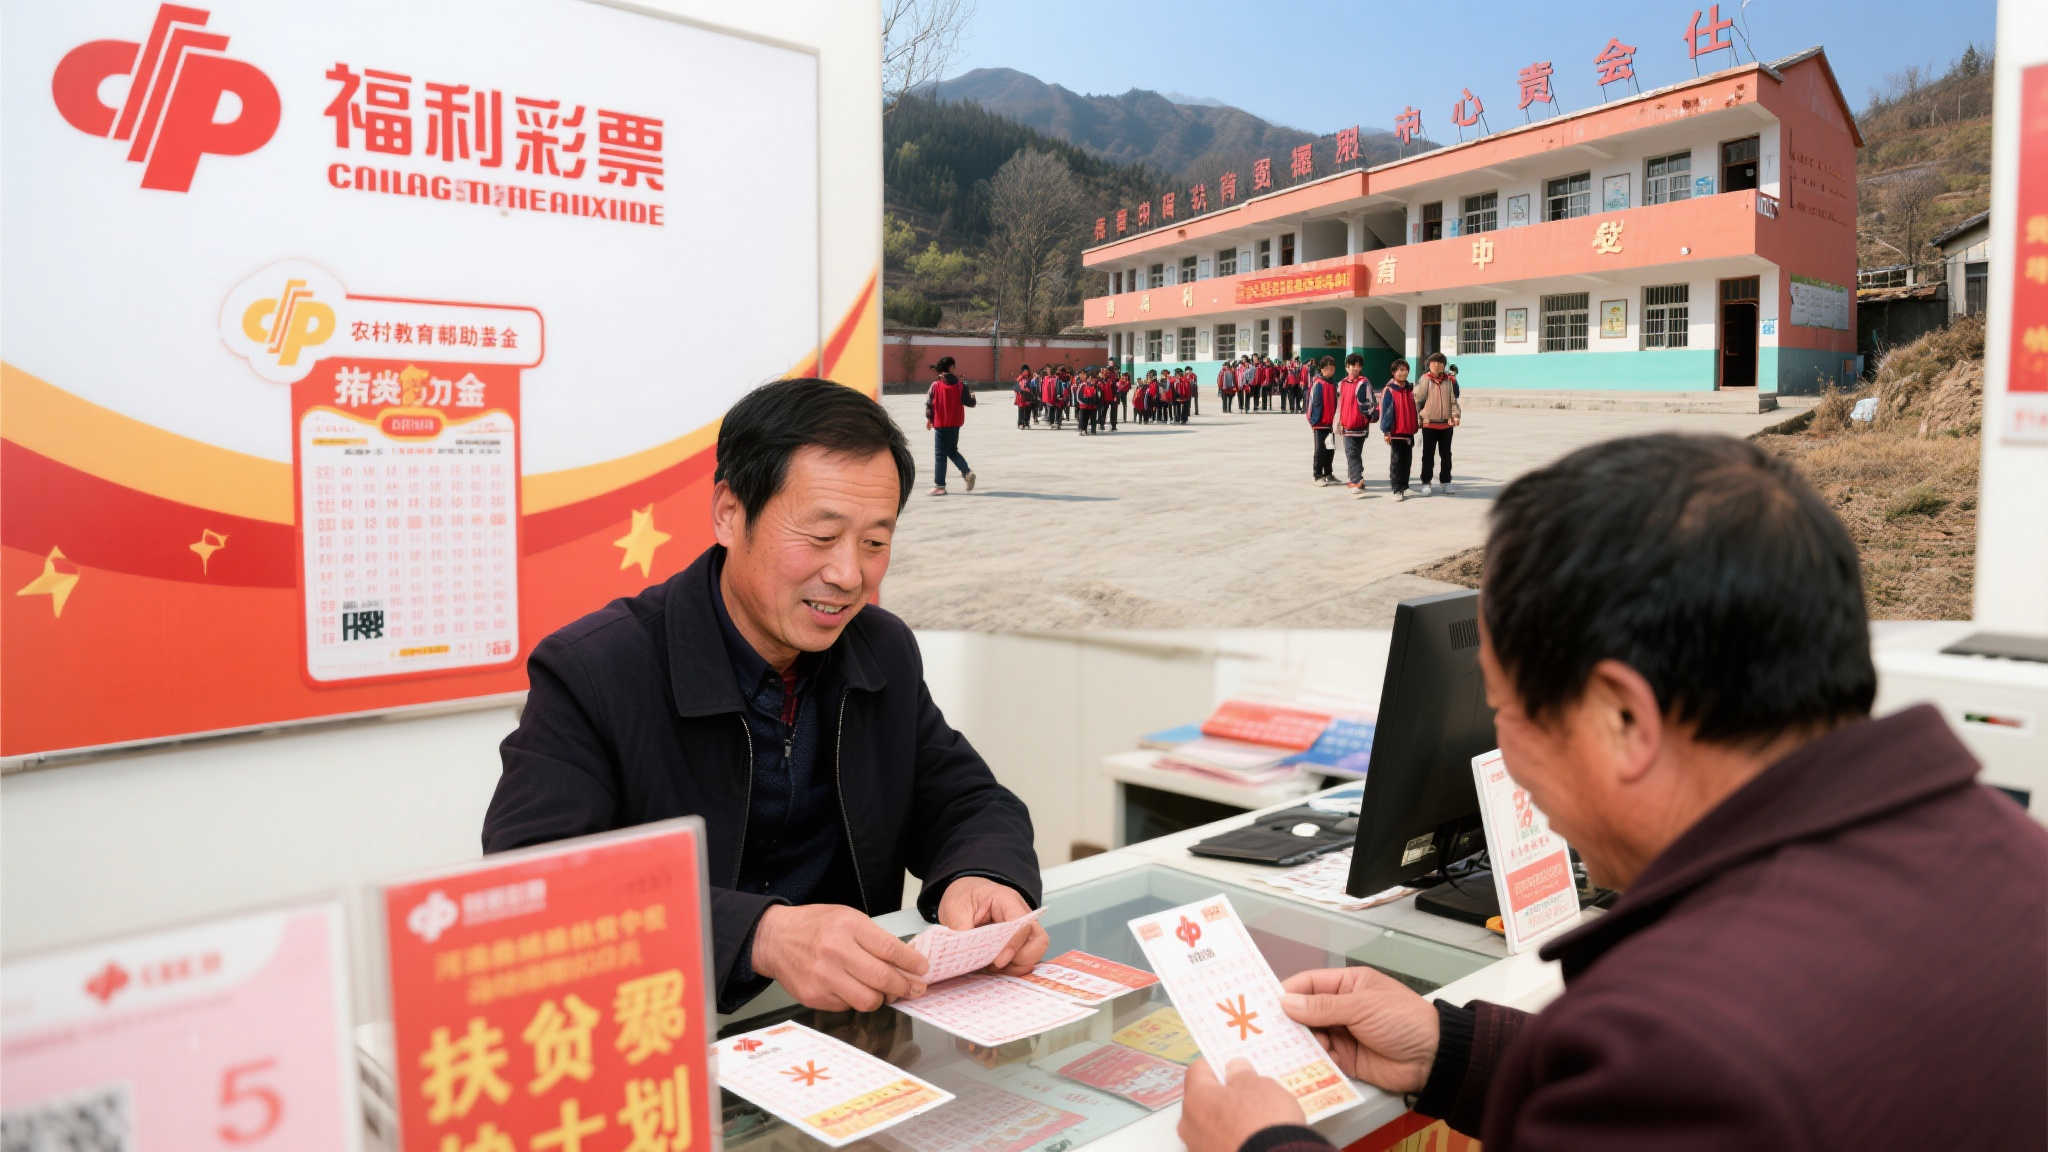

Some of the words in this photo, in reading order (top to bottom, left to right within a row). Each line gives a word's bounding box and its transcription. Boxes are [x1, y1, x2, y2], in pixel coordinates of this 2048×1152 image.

[324, 62, 664, 191] 福利彩票
[217, 1056, 286, 1146] 5
